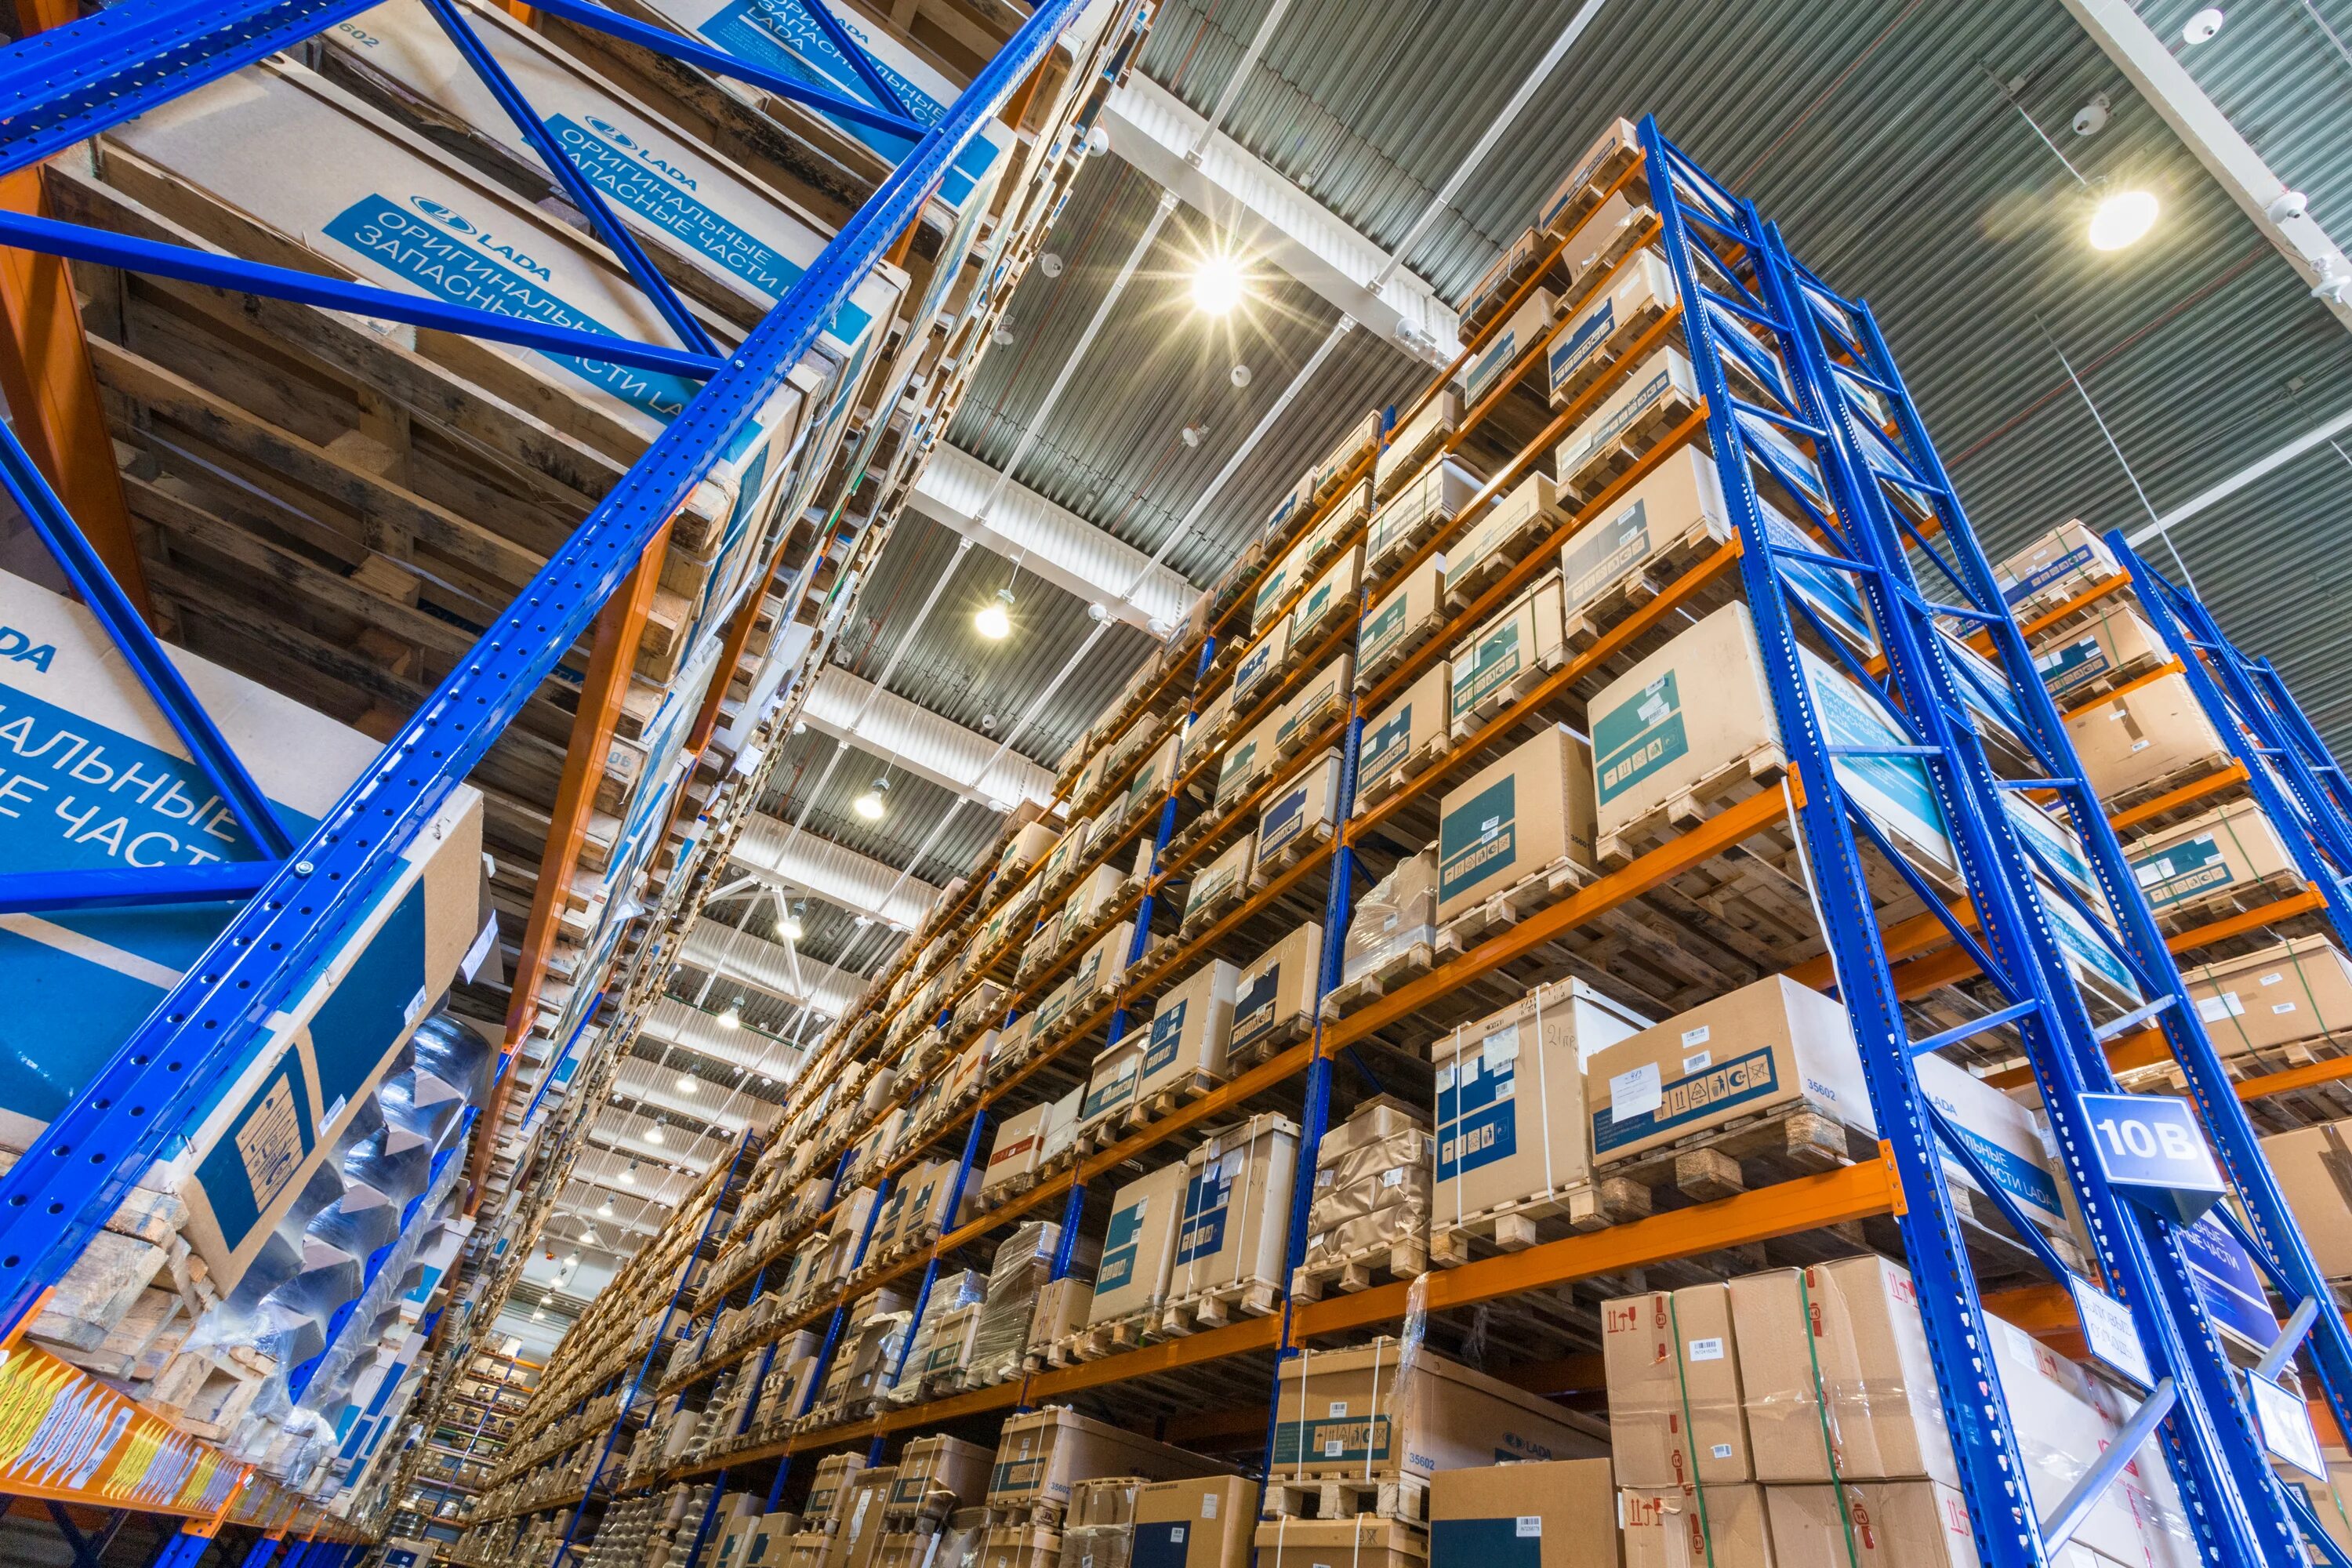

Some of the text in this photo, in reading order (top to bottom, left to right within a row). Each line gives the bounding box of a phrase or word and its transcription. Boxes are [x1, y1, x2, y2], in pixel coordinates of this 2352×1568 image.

[746, 6, 804, 50] LADA
[829, 9, 869, 44] ADA
[638, 150, 698, 192] LADA
[561, 129, 772, 266] ОРИГИНАЛЬНЫЕ
[477, 234, 552, 283] LADA
[699, 231, 776, 288] ЧАСТИ
[0, 706, 238, 843] АЛЬНЫЕ
[1806, 1078, 1836, 1102] 35602
[1927, 1091, 1958, 1116] LADA
[1954, 1128, 2009, 1168] АЛЬНЫЕ
[2024, 1181, 2055, 1208] LADA
[2202, 1238, 2241, 1271] ЧАСТИ
[1409, 1452, 1436, 1471] 35602
